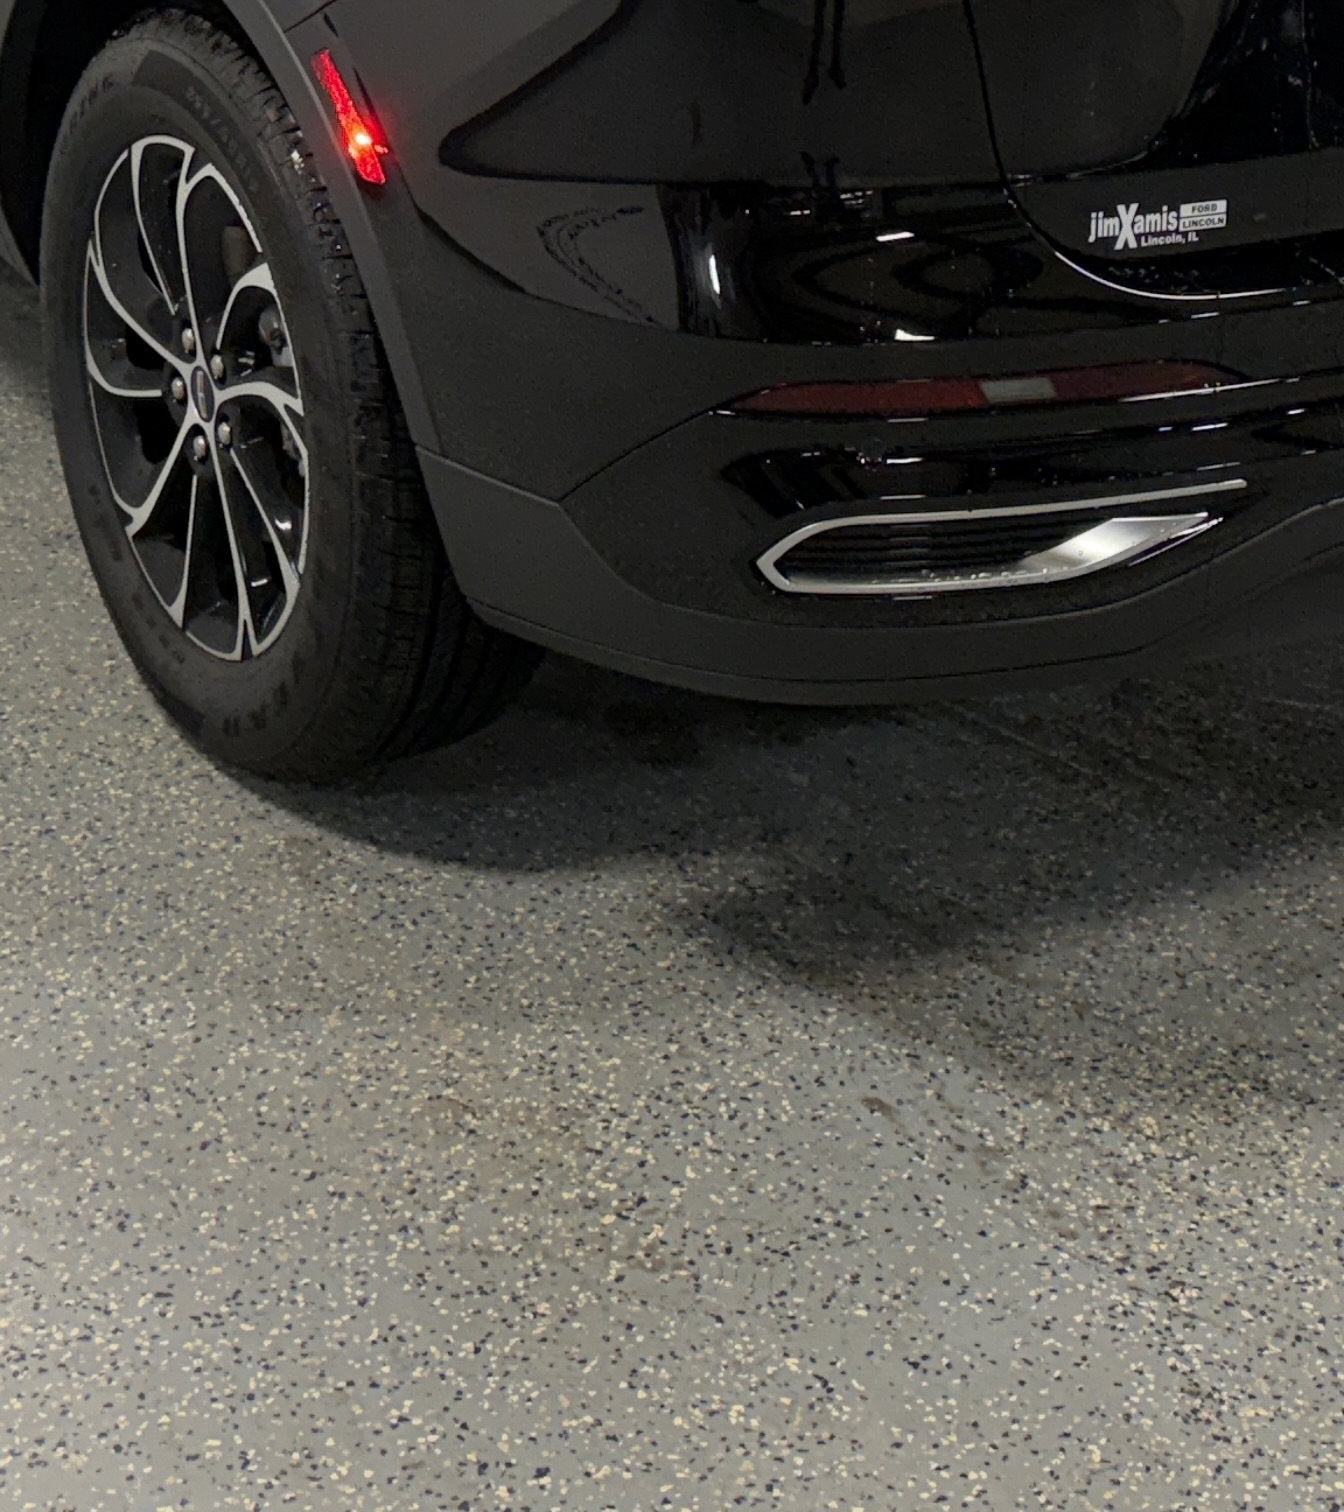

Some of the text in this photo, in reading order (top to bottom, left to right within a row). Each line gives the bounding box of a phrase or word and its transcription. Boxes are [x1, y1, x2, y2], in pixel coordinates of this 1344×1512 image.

[1191, 202, 1218, 214] FORD
[1182, 217, 1225, 230] LINCOLN
[1140, 231, 1200, 247] Lincoln, IL
